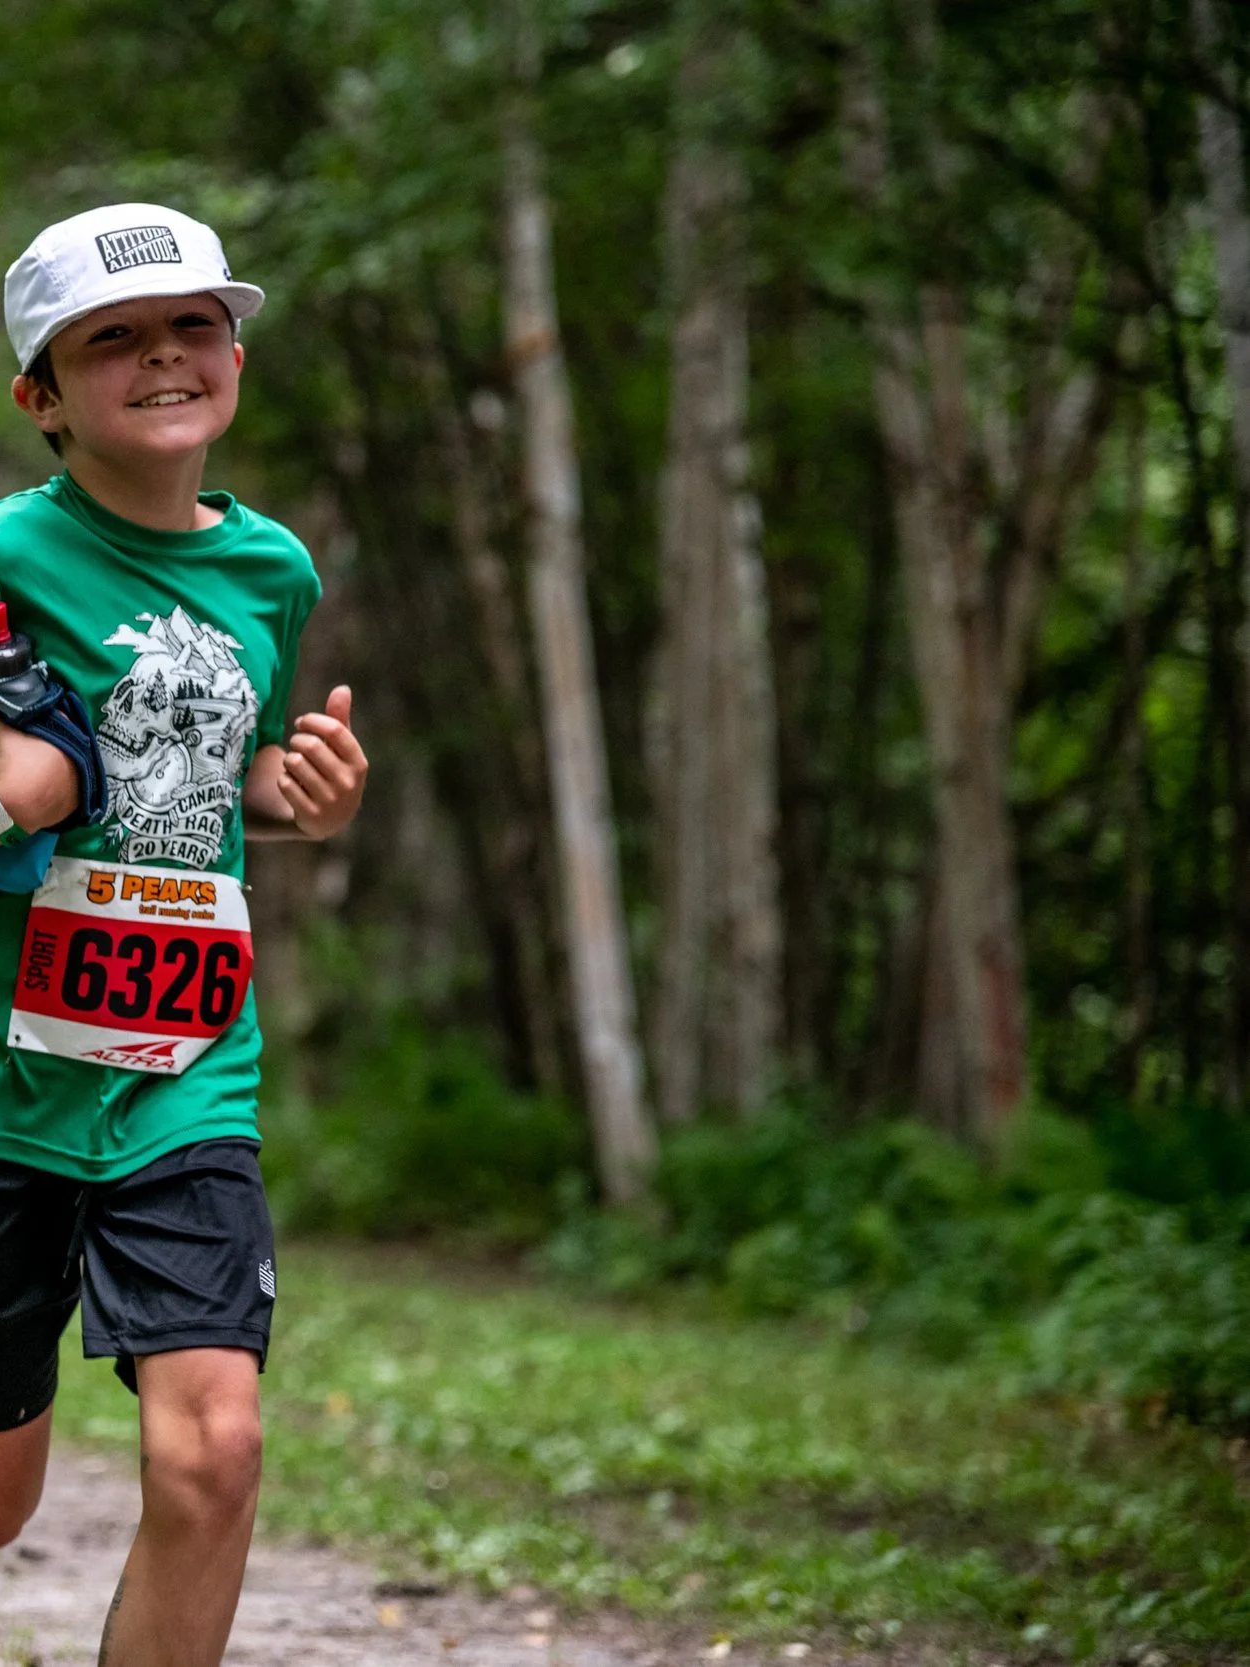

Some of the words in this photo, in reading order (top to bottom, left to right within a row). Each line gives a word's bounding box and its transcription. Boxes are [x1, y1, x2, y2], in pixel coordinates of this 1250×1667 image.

[99, 228, 170, 262] ATTITUDE
[110, 234, 181, 272] ALTITUDE
[124, 806, 172, 834] DEATH
[133, 841, 156, 857] 20
[161, 839, 208, 865] YEARS
[86, 870, 116, 904] 5
[120, 874, 217, 905] PEAKS
[25, 929, 58, 992] SPORT
[61, 928, 240, 1026] 6326
[79, 1048, 175, 1069] ALTRA
